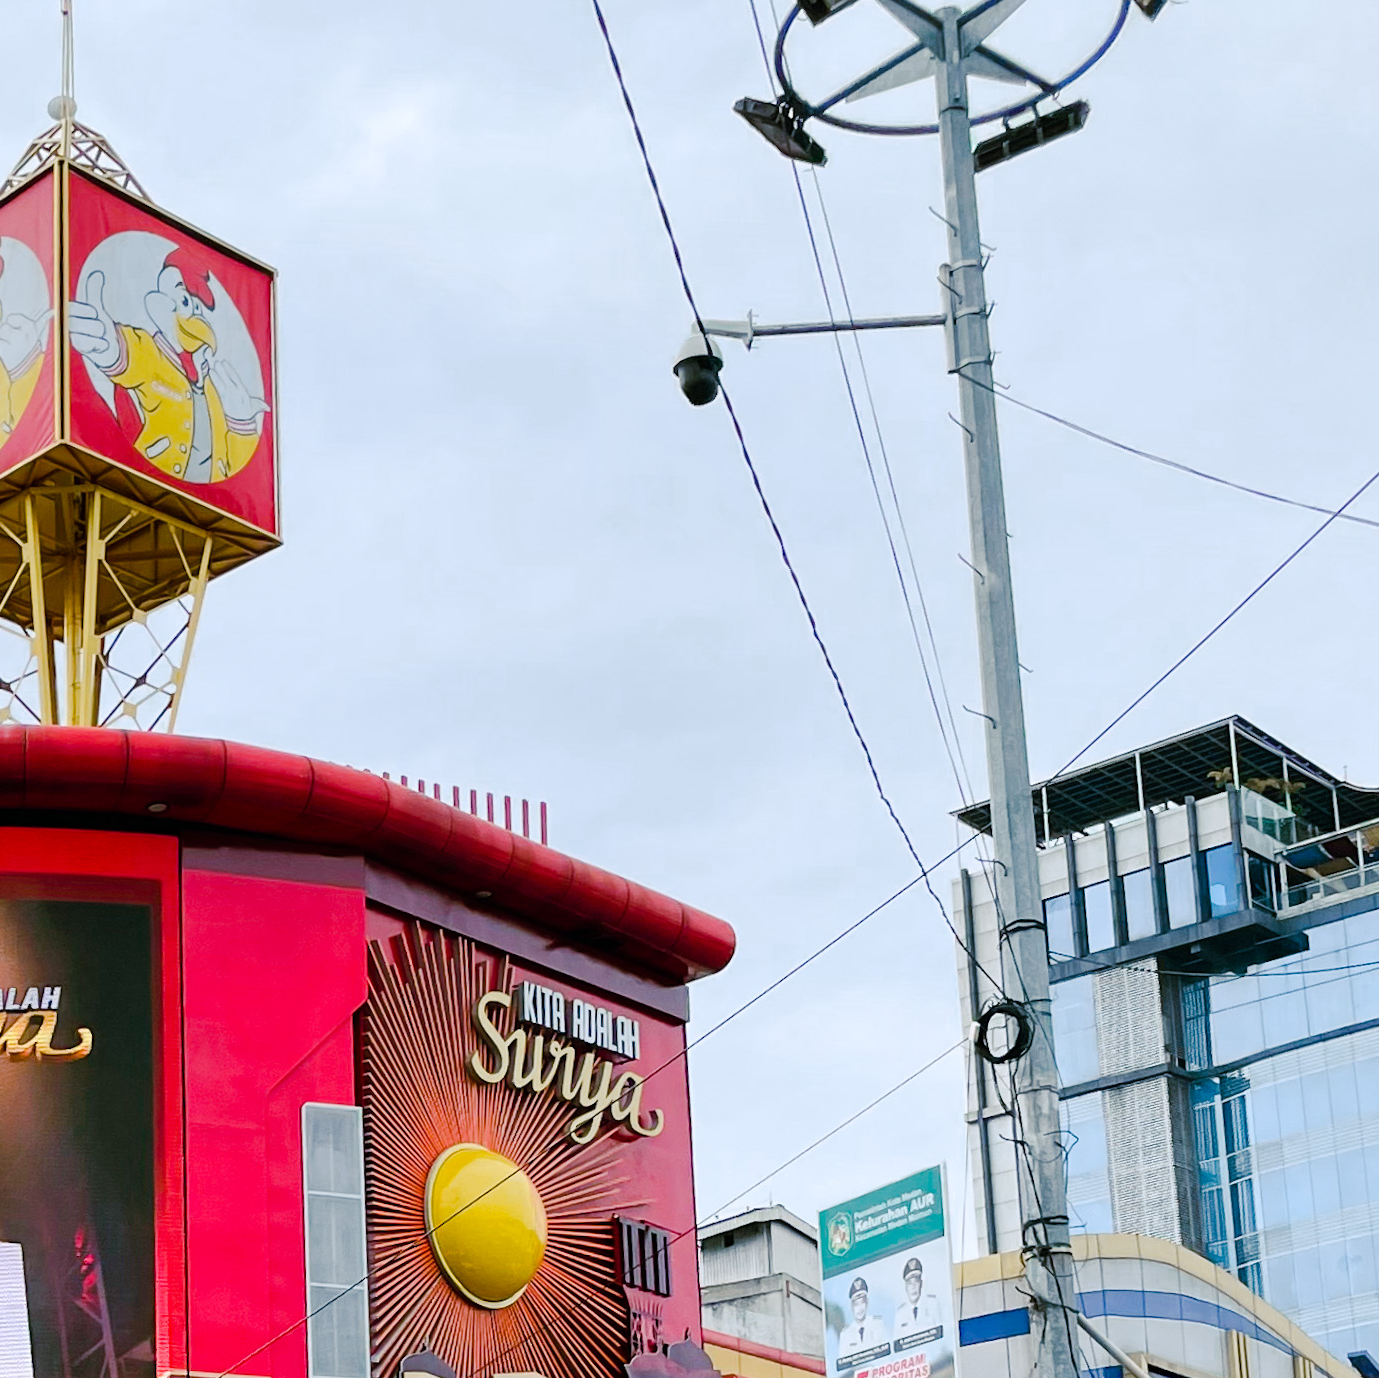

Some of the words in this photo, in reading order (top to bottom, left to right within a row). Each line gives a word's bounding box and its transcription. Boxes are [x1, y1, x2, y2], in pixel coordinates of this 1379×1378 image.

[523, 981, 566, 1033] KITA
[572, 999, 640, 1060] ADALAH
[471, 991, 664, 1145] Surya
[854, 1206, 908, 1234] Kelurahan
[910, 1192, 934, 1213] AUR
